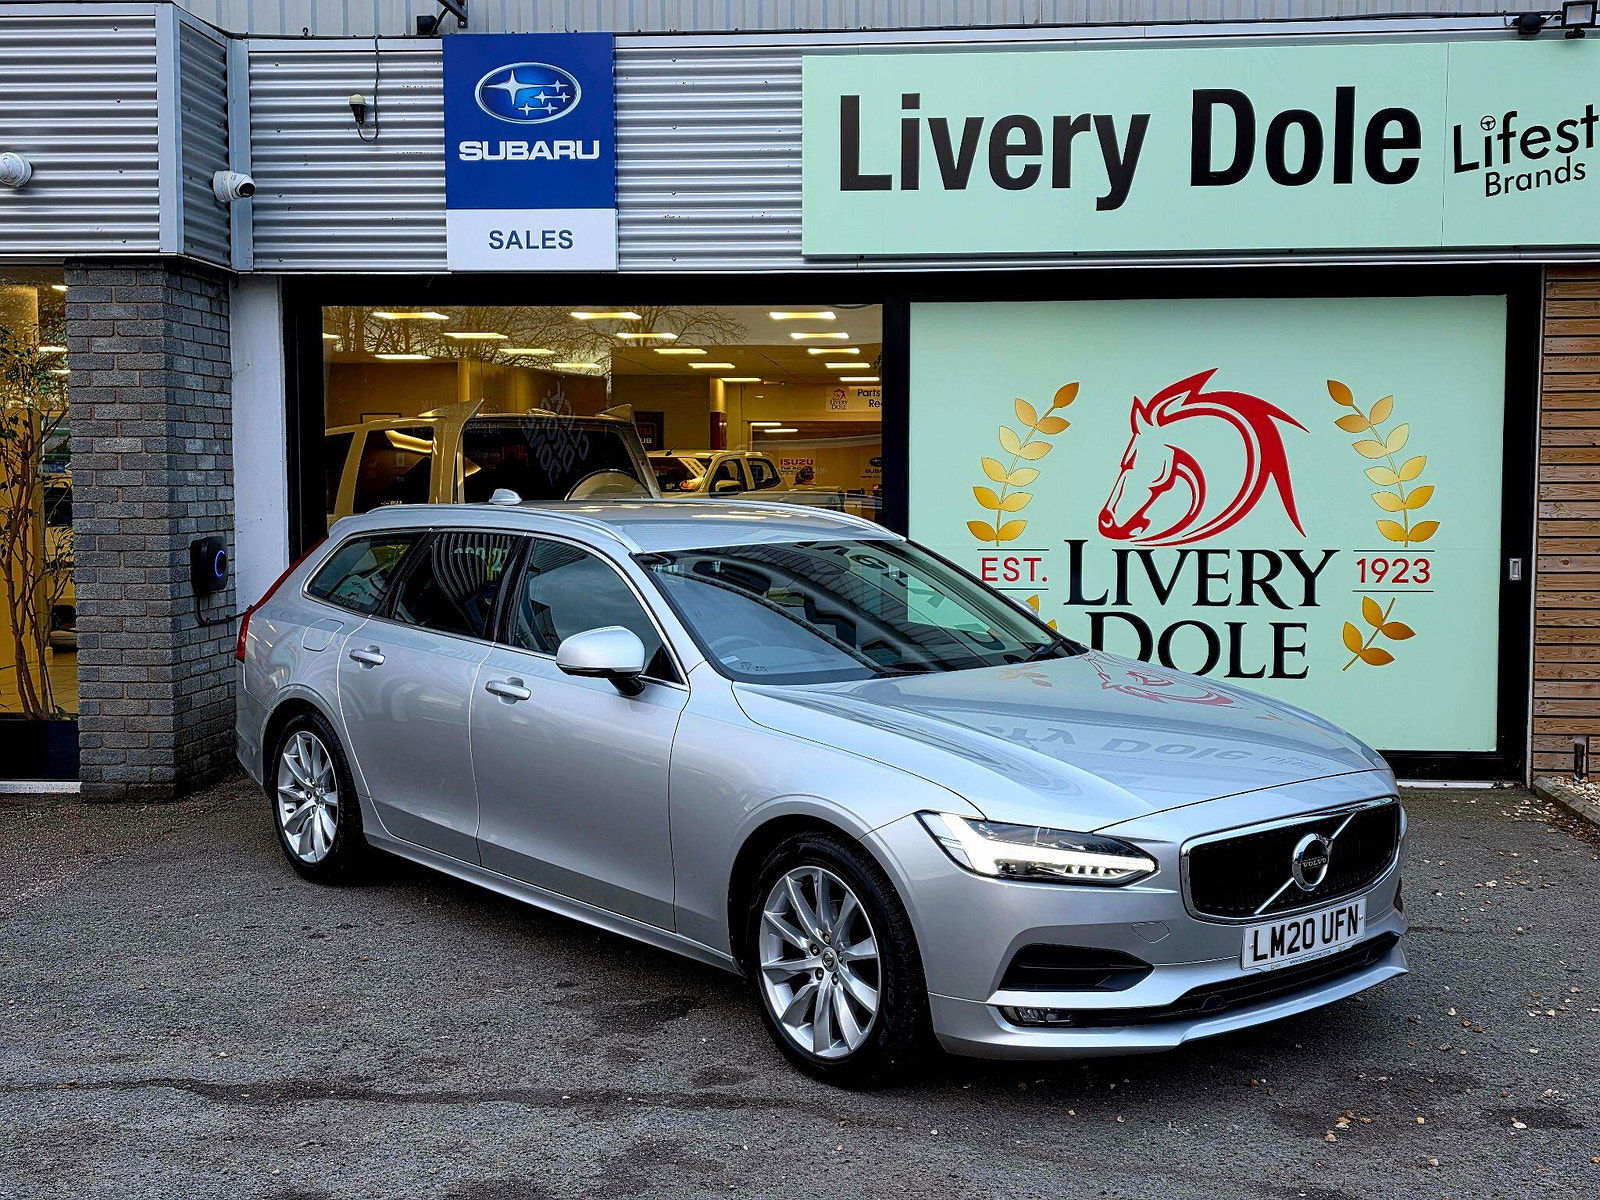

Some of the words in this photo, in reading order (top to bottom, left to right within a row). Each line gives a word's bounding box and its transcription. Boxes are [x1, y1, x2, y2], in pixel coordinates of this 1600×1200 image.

[458, 139, 601, 162] SUBARU
[839, 92, 1150, 212] Livery
[1190, 86, 1421, 187] Dole
[1485, 156, 1586, 197] Brands
[488, 229, 574, 250] SALES
[857, 389, 880, 397] Parts
[868, 399, 883, 408] Re
[780, 458, 814, 466] ISUZU
[981, 557, 1048, 584] EST.
[1356, 557, 1431, 585] 1923
[1063, 539, 1341, 610] LIVERY
[1085, 611, 1309, 679] DOLE
[1302, 857, 1327, 868] VOLVO
[1253, 917, 1316, 961] LM20
[1321, 903, 1360, 944] UFN
